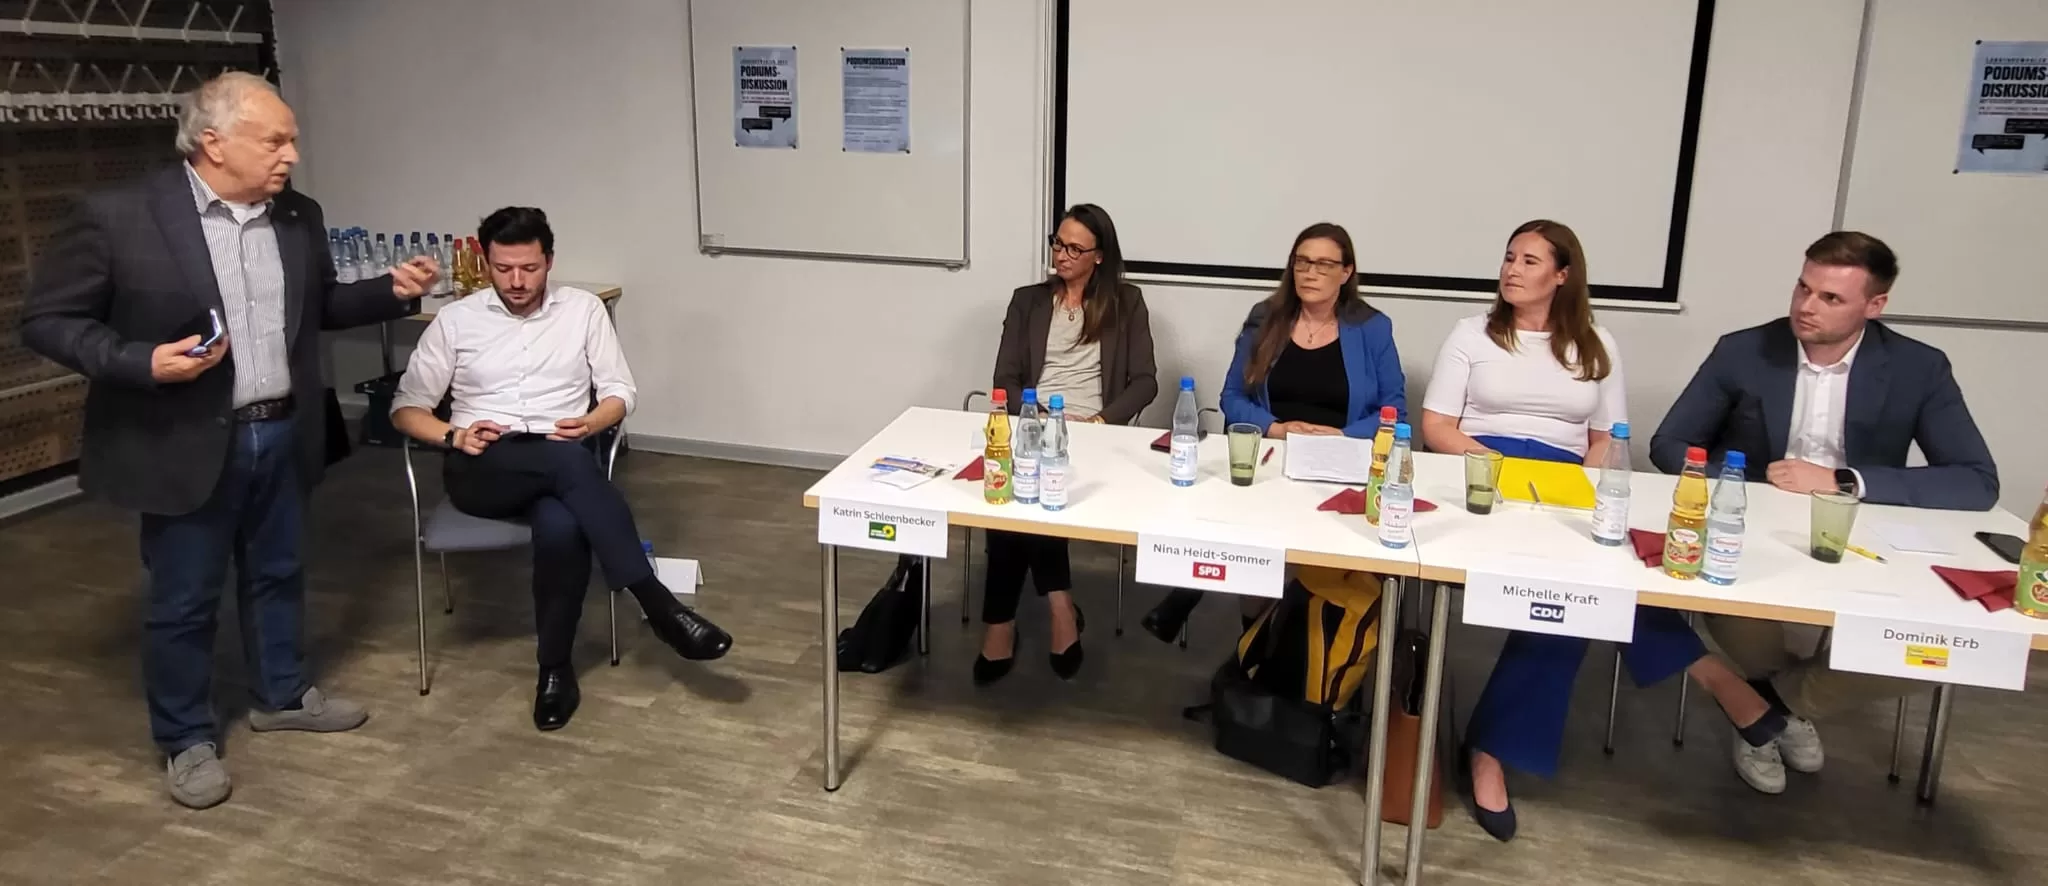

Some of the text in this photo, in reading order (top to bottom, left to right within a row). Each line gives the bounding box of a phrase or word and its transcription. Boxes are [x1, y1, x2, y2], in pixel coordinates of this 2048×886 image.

[740, 65, 780, 77] PODIUMS-
[741, 79, 788, 90] DISKUSSION
[833, 506, 936, 527] Katrin Schleenbecker
[1153, 543, 1272, 566] Nina Heidt-Sommer
[1198, 564, 1221, 577] SPD
[1502, 585, 1599, 606] Michelle Kraft
[1530, 606, 1564, 619] CDU
[1883, 628, 1980, 650] Dominik Erb
